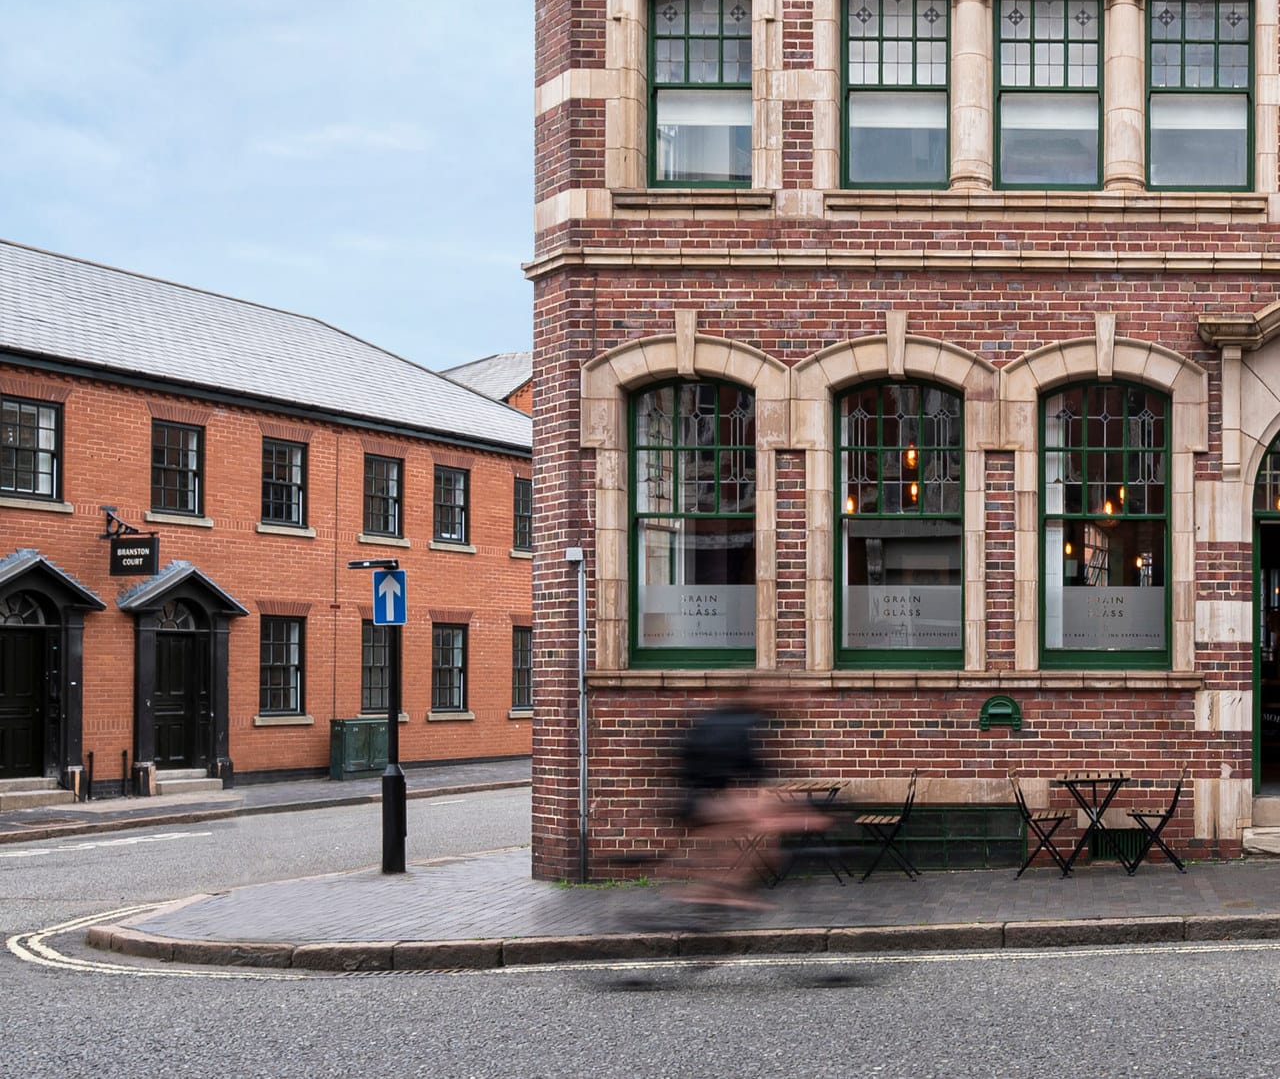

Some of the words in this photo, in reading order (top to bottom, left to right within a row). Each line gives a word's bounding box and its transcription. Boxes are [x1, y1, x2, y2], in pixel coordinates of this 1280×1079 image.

[117, 548, 150, 556] BRANSTON
[122, 558, 143, 566] COURT
[883, 595, 921, 603] GRAIN
[1088, 596, 1125, 604] AIN
[883, 609, 921, 617] GLASS
[1088, 610, 1125, 618] ASS
